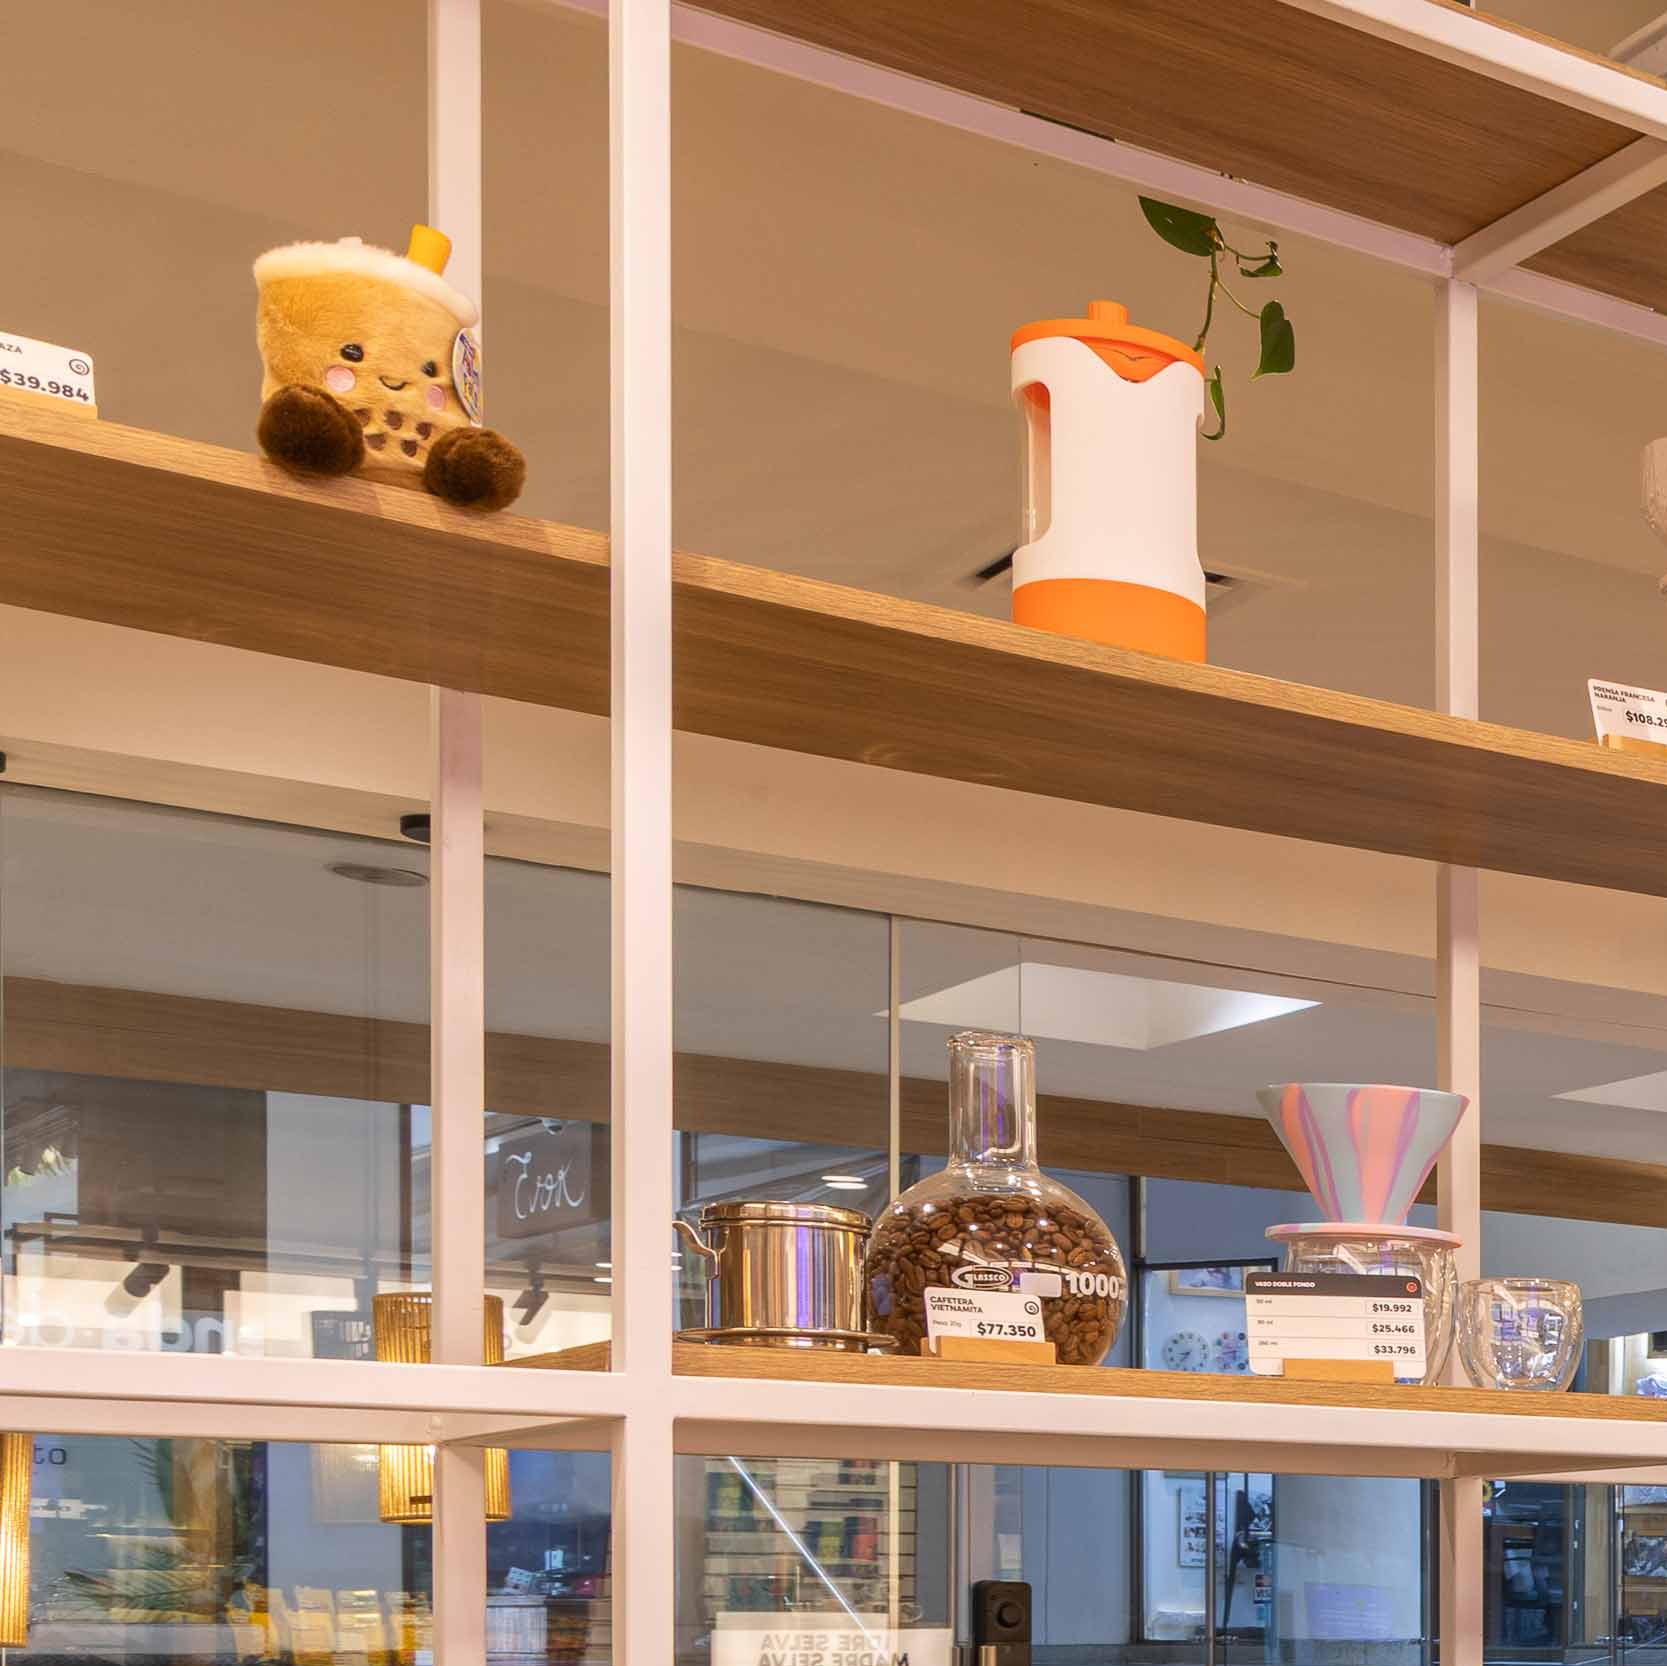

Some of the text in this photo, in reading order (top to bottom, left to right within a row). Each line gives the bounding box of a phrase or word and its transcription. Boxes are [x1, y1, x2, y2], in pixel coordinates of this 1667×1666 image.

[0, 369, 89, 401] $39.984
[1065, 1272, 1119, 1299] 1000
[930, 1296, 974, 1306] CAFETERA
[931, 1304, 983, 1313] VIETNAMITA
[1372, 1303, 1412, 1313] $19.992
[977, 1321, 1036, 1337] $77.350
[1372, 1324, 1415, 1334] $25.466
[1374, 1345, 1416, 1355] $33.796
